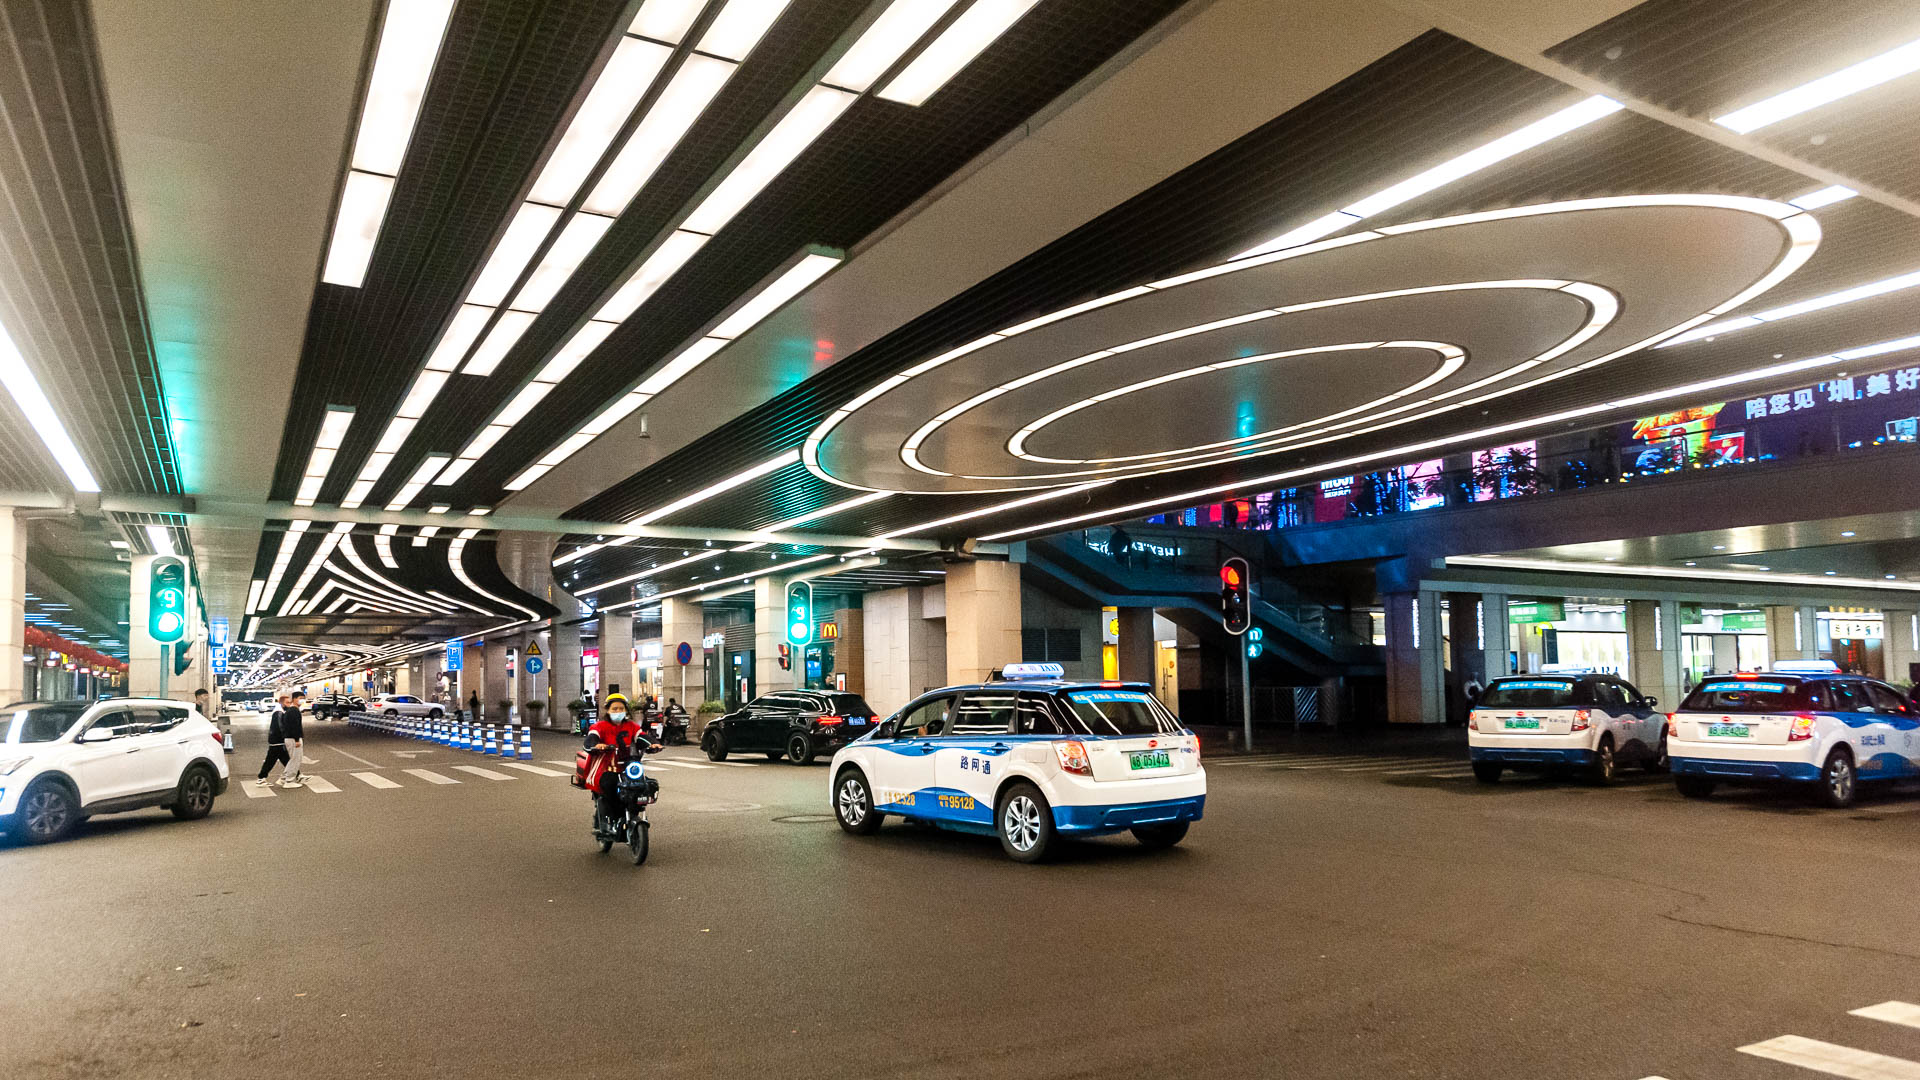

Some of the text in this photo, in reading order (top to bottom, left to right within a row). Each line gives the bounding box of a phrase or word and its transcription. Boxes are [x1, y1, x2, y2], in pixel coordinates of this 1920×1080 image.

[164, 590, 175, 608] 9
[797, 606, 805, 620] 9
[960, 756, 991, 774] 路网通
[893, 792, 916, 806] 12328
[949, 795, 975, 810] 95128
